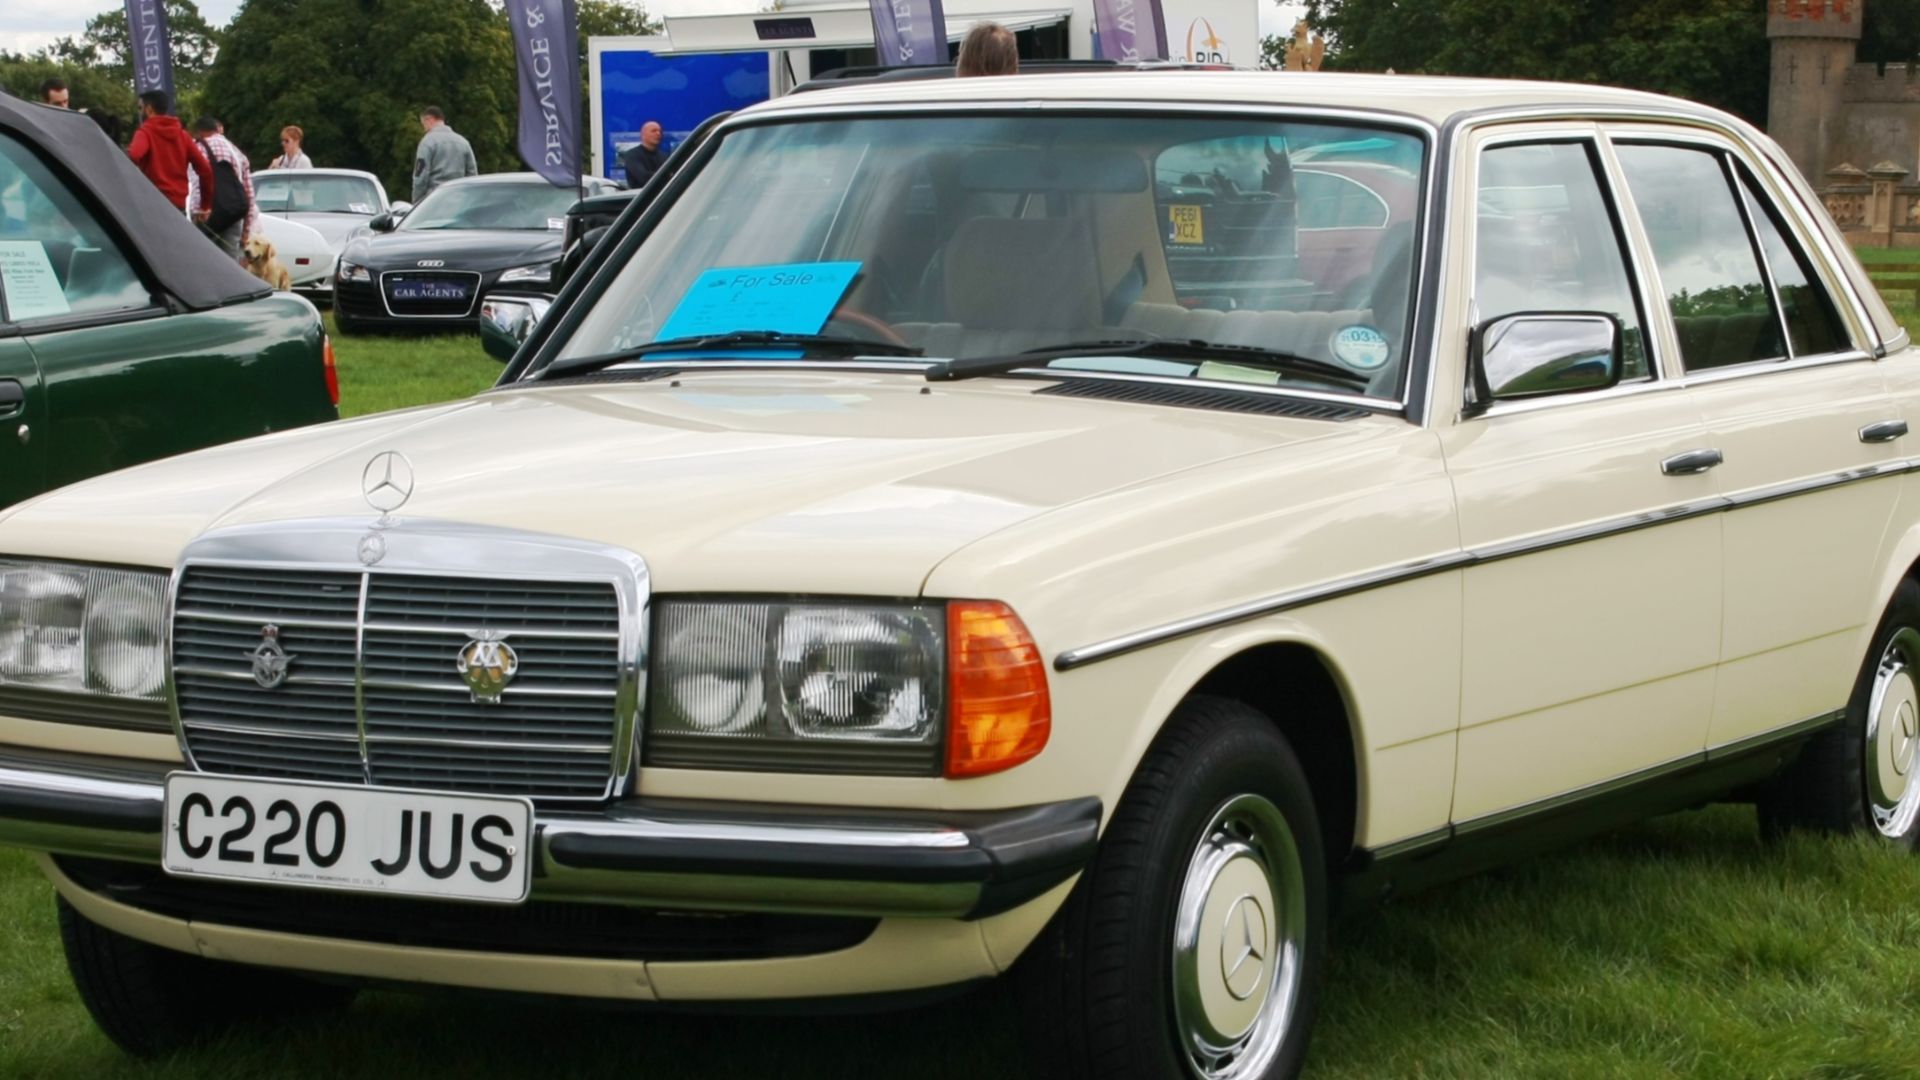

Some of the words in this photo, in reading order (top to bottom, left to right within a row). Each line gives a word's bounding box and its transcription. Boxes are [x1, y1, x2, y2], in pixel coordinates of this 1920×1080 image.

[140, 0, 163, 90] GENT
[394, 289, 417, 297] CAR
[421, 289, 464, 297] AGENTS
[729, 274, 765, 289] For
[769, 272, 814, 288] Sale
[179, 792, 346, 868] C220
[370, 810, 515, 882] JUS
